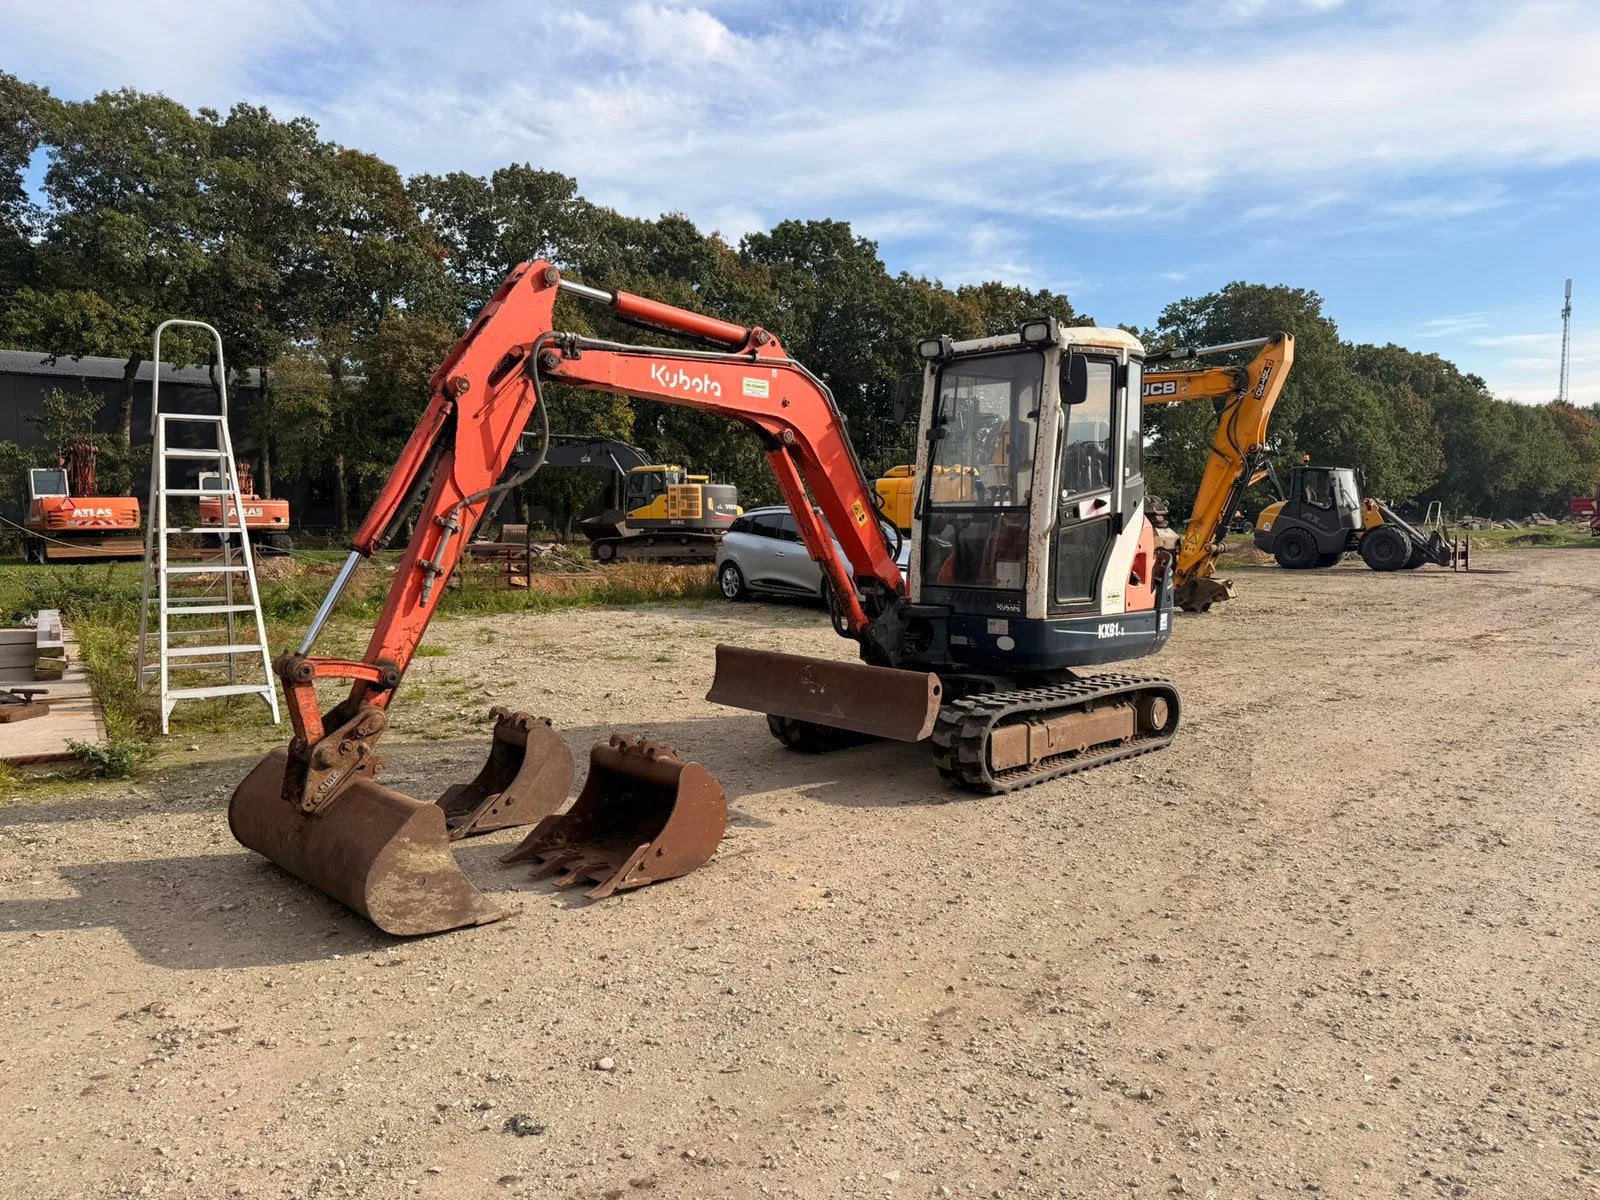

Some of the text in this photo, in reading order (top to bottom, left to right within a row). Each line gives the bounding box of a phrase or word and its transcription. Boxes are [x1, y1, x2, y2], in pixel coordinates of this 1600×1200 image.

[651, 363, 722, 397] Kubota
[1142, 381, 1176, 396] JCB
[71, 508, 113, 518] ATLAS
[228, 507, 263, 517] ALAS
[997, 603, 1020, 612] Kubota
